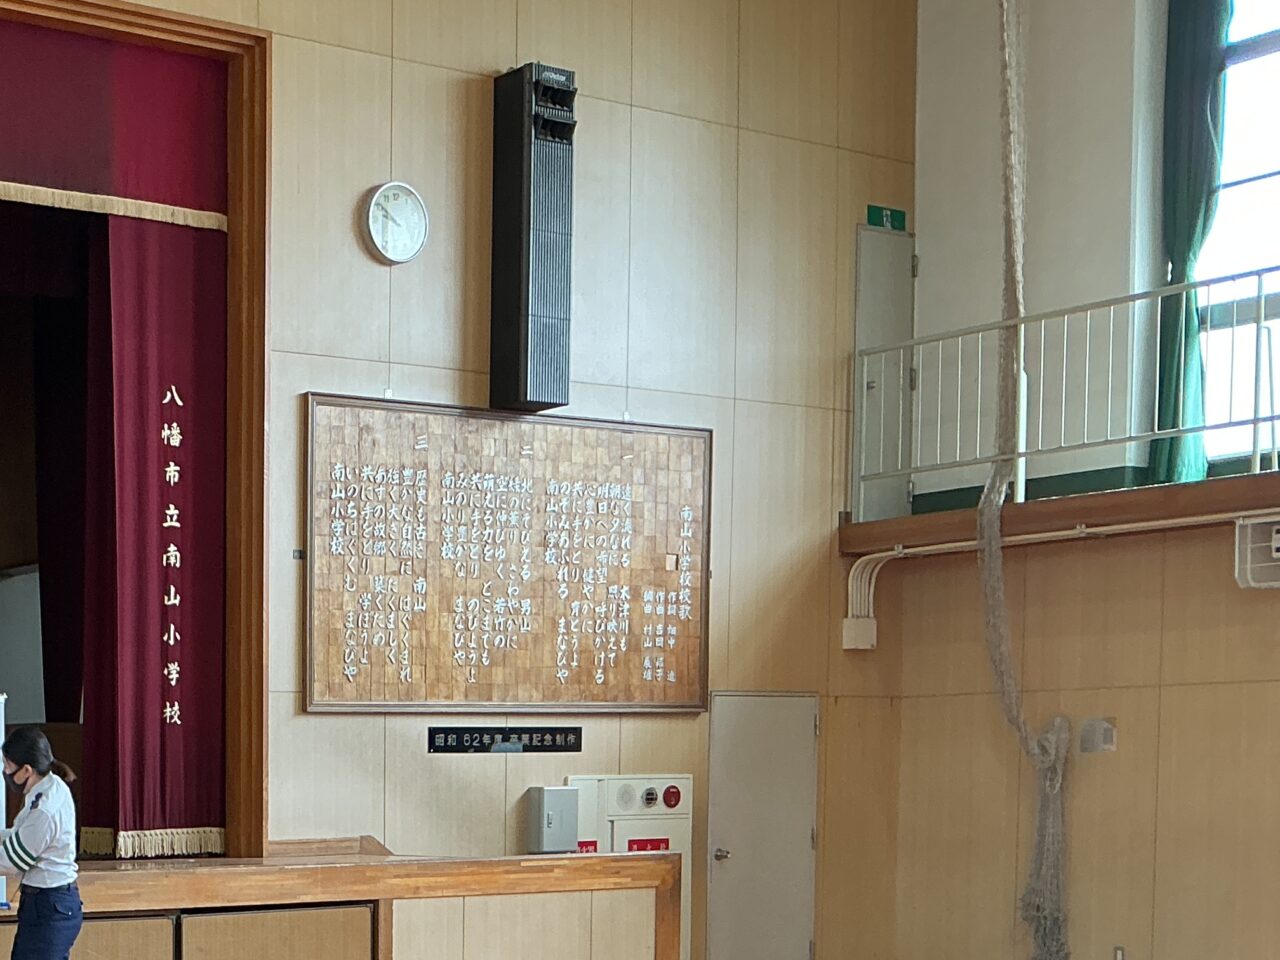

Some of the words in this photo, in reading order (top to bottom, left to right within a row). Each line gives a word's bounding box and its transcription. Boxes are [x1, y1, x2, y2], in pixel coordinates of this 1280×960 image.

[161, 384, 184, 725] 八幡市立南山小学校
[330, 465, 345, 556] 南山小学校
[440, 471, 455, 560] 南山小学校
[545, 479, 559, 565] 南山小学校
[413, 577, 426, 612] 南山
[679, 506, 693, 620] 南山小学校校歌
